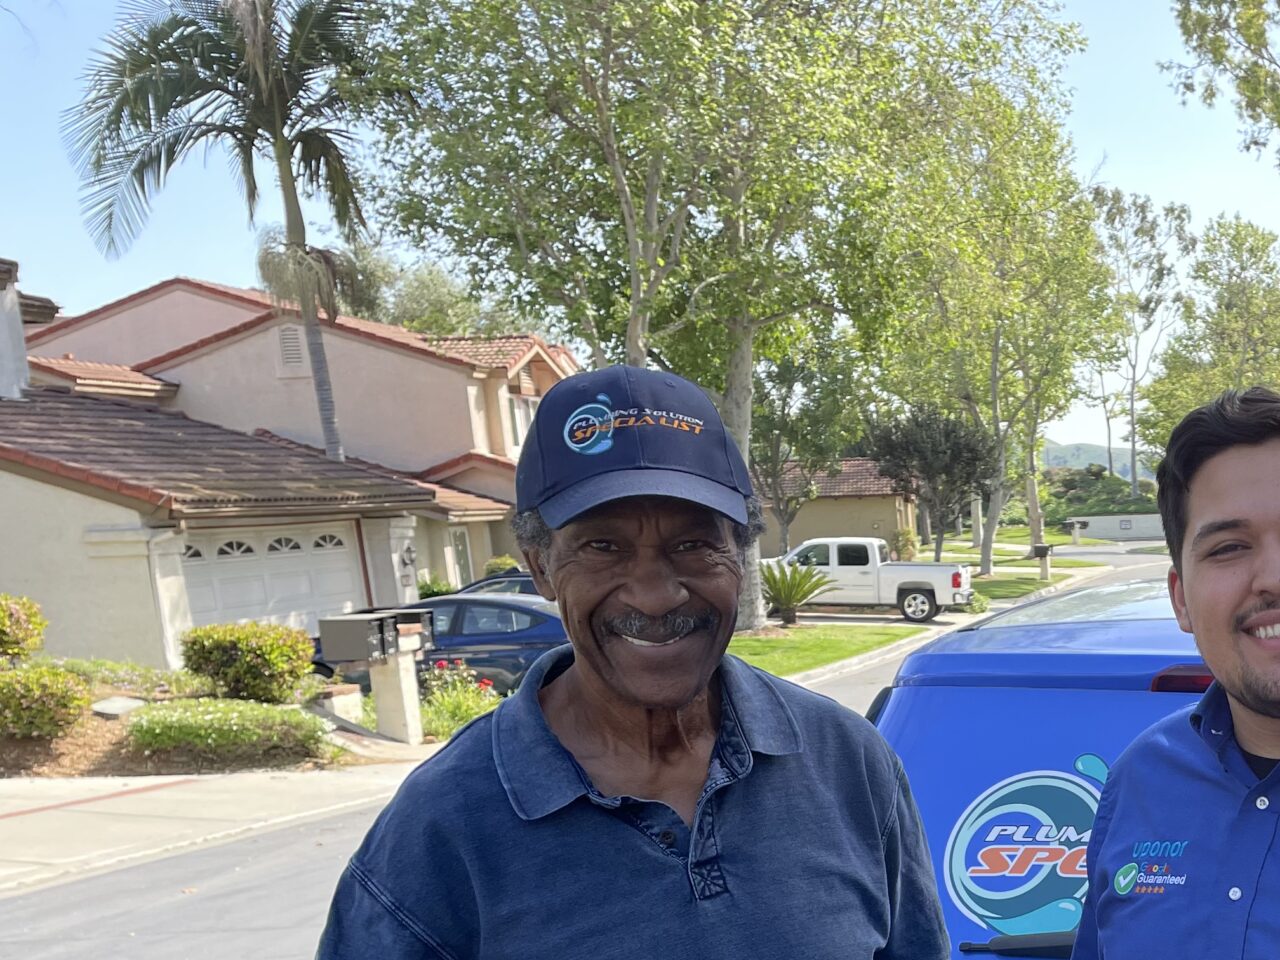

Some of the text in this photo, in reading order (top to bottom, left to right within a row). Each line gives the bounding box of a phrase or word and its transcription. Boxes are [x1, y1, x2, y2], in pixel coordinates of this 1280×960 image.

[571, 416, 705, 441] SPECIALIST
[1132, 840, 1188, 859] uponor
[1136, 873, 1187, 885] Guaranteed
